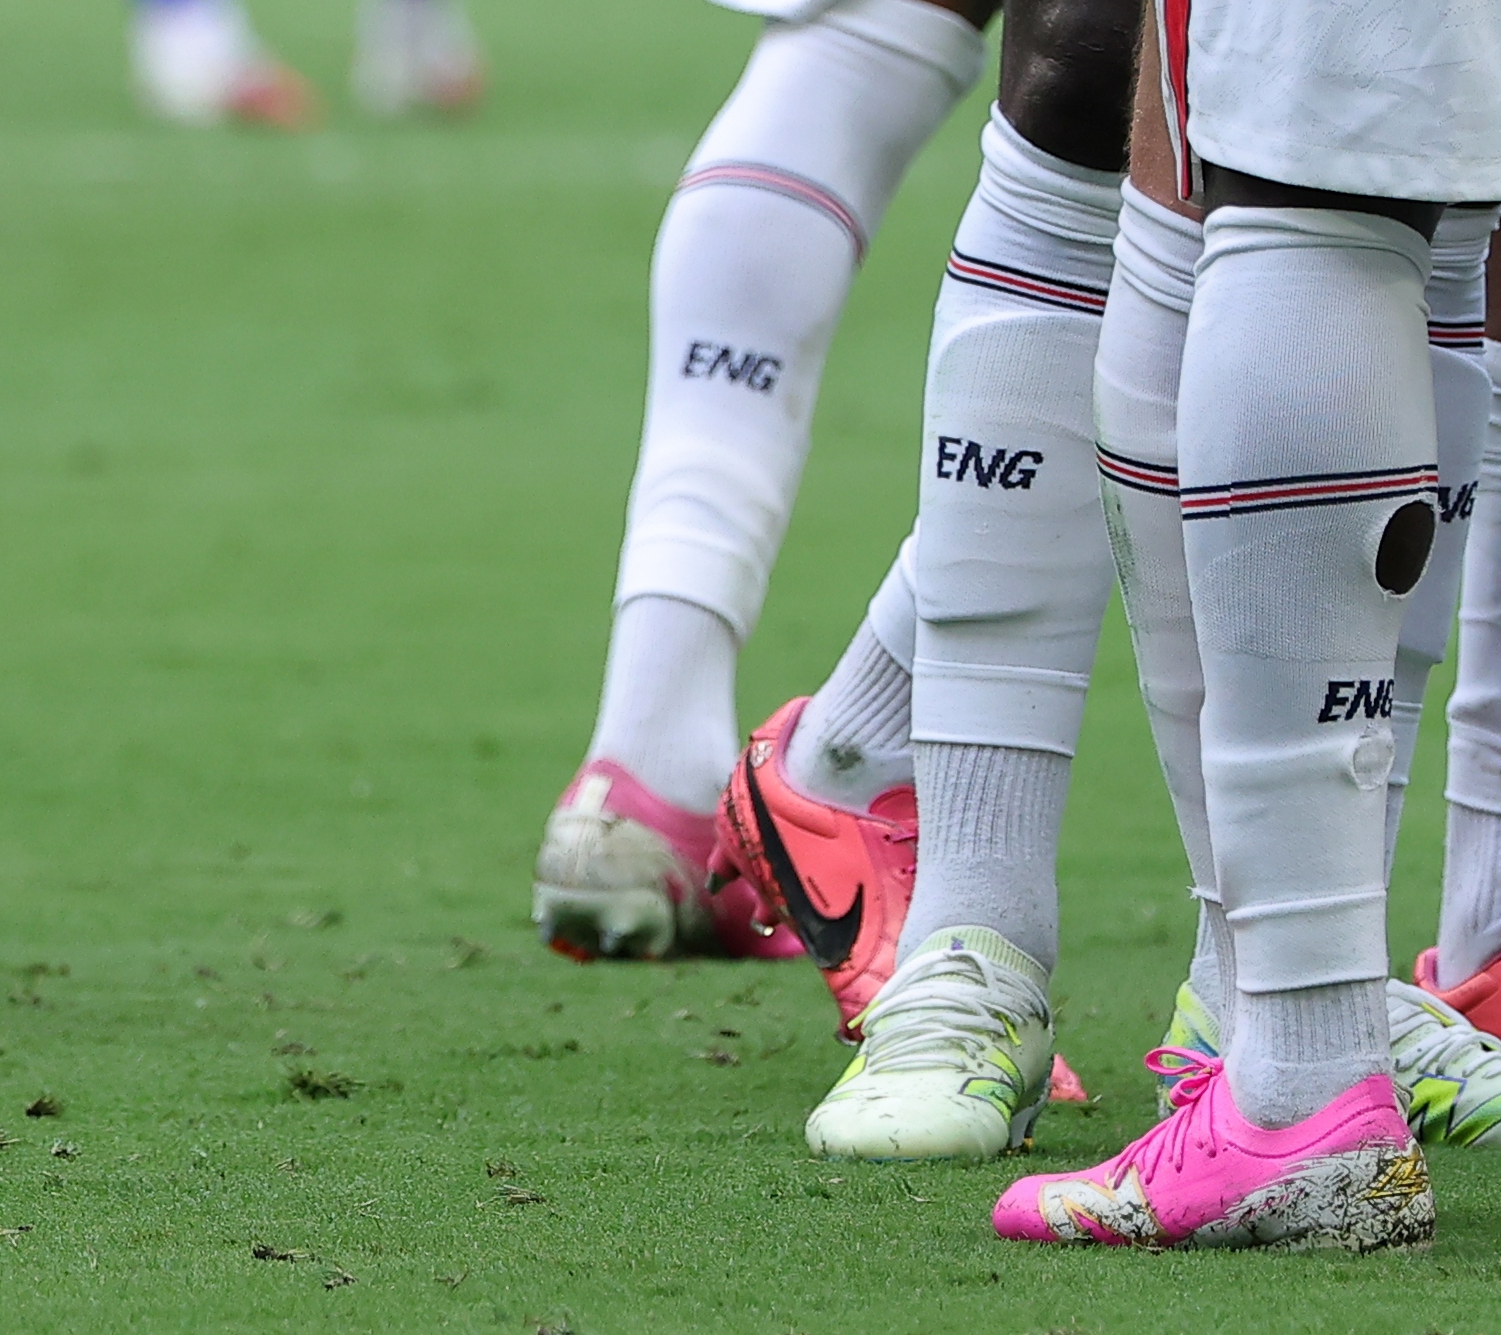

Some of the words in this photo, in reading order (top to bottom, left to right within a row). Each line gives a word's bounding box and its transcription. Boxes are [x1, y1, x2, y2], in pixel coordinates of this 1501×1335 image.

[683, 340, 782, 393] ENG
[936, 436, 1044, 490] ENG
[1438, 480, 1478, 524] NG
[1317, 679, 1395, 724] ENG
